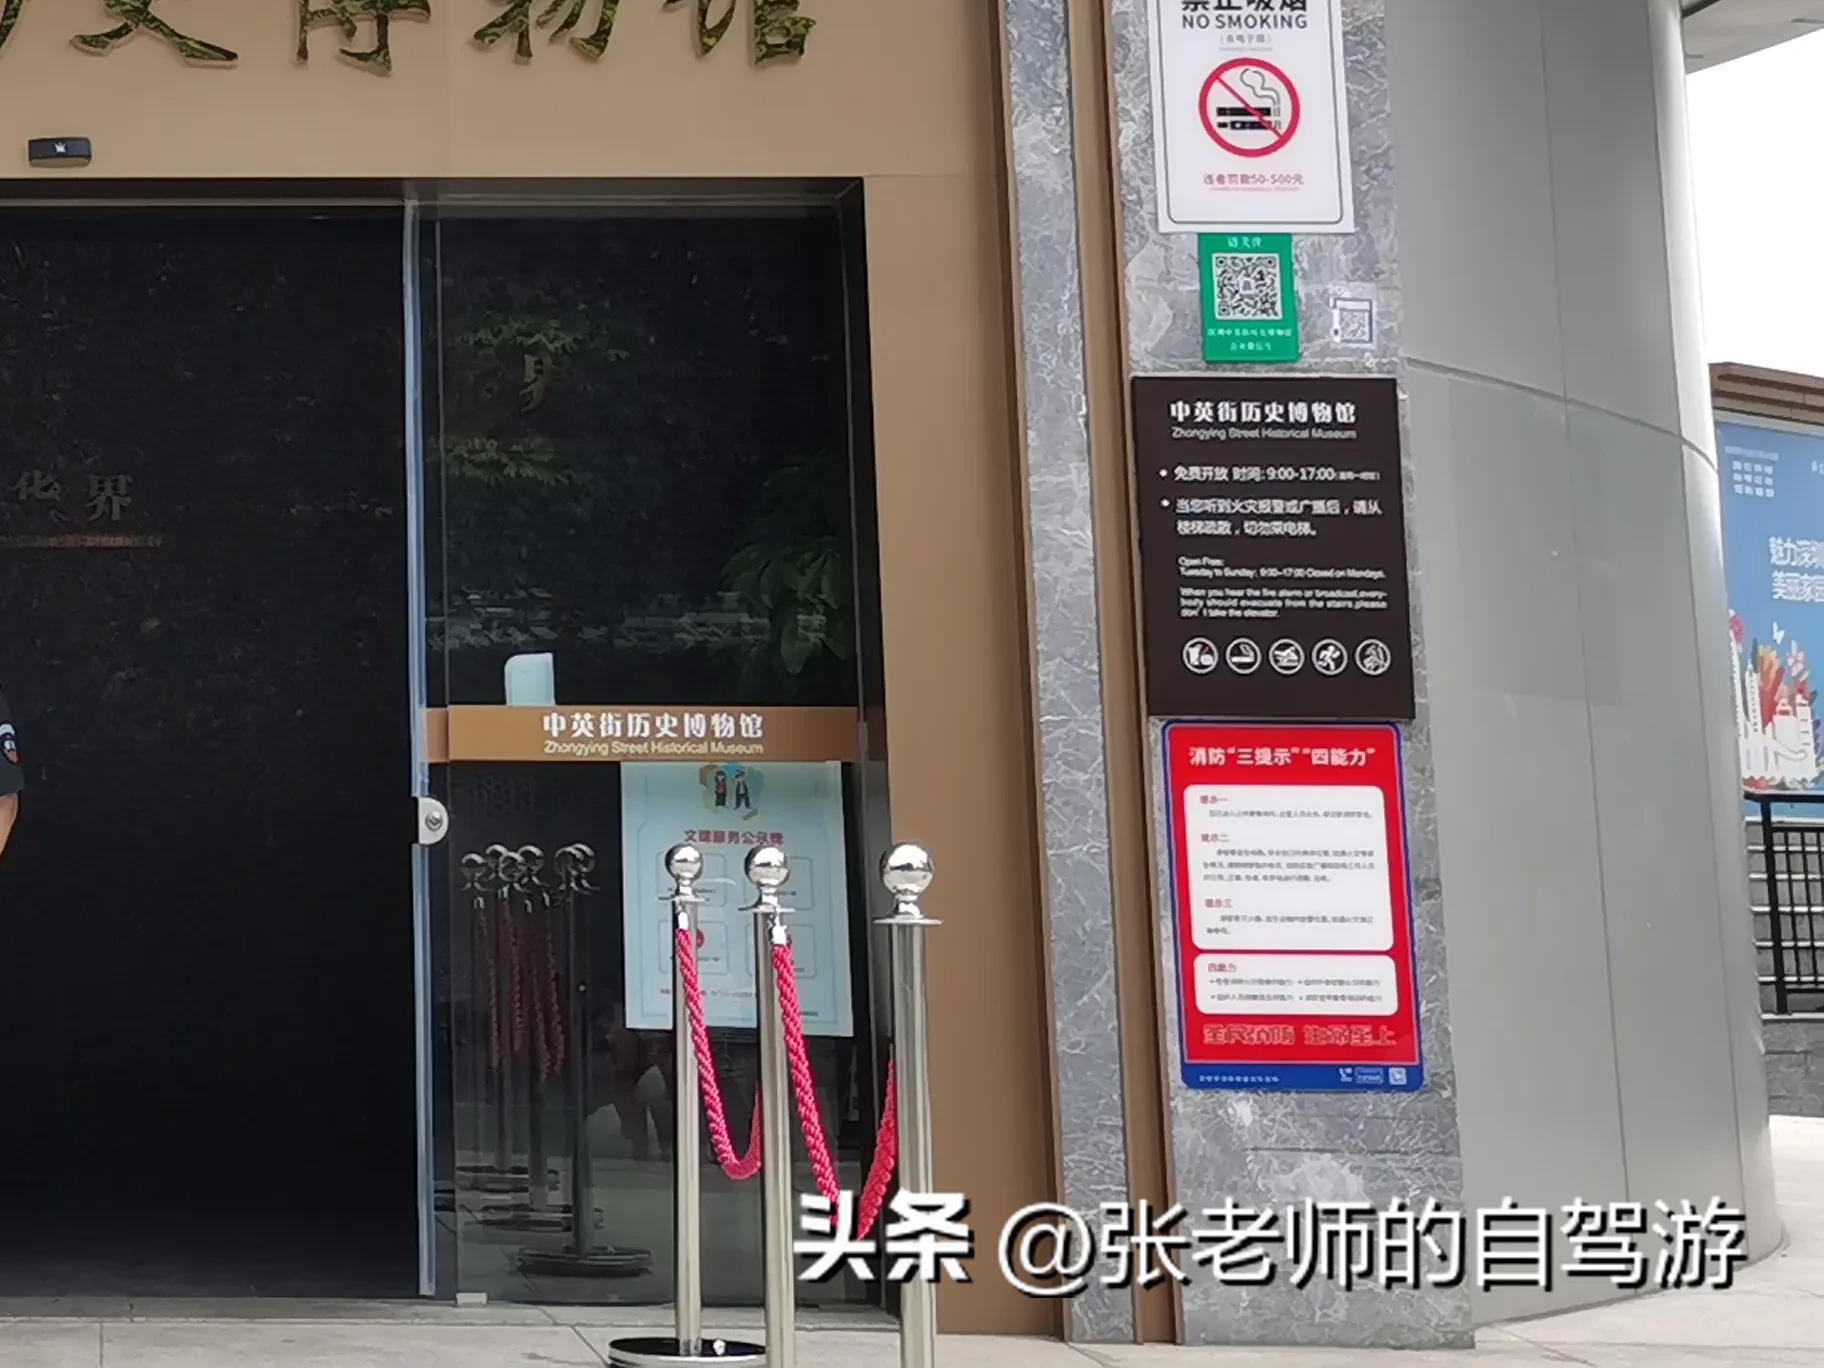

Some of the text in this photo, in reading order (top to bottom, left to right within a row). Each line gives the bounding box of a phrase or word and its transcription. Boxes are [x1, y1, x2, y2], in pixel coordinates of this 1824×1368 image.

[1182, 14, 1308, 29] NO SMOKING
[1170, 400, 1356, 423] 中英街历史博物馆
[543, 712, 764, 739] 中英街历史博物馆
[544, 740, 764, 756] Zhongying Street Historical Museum
